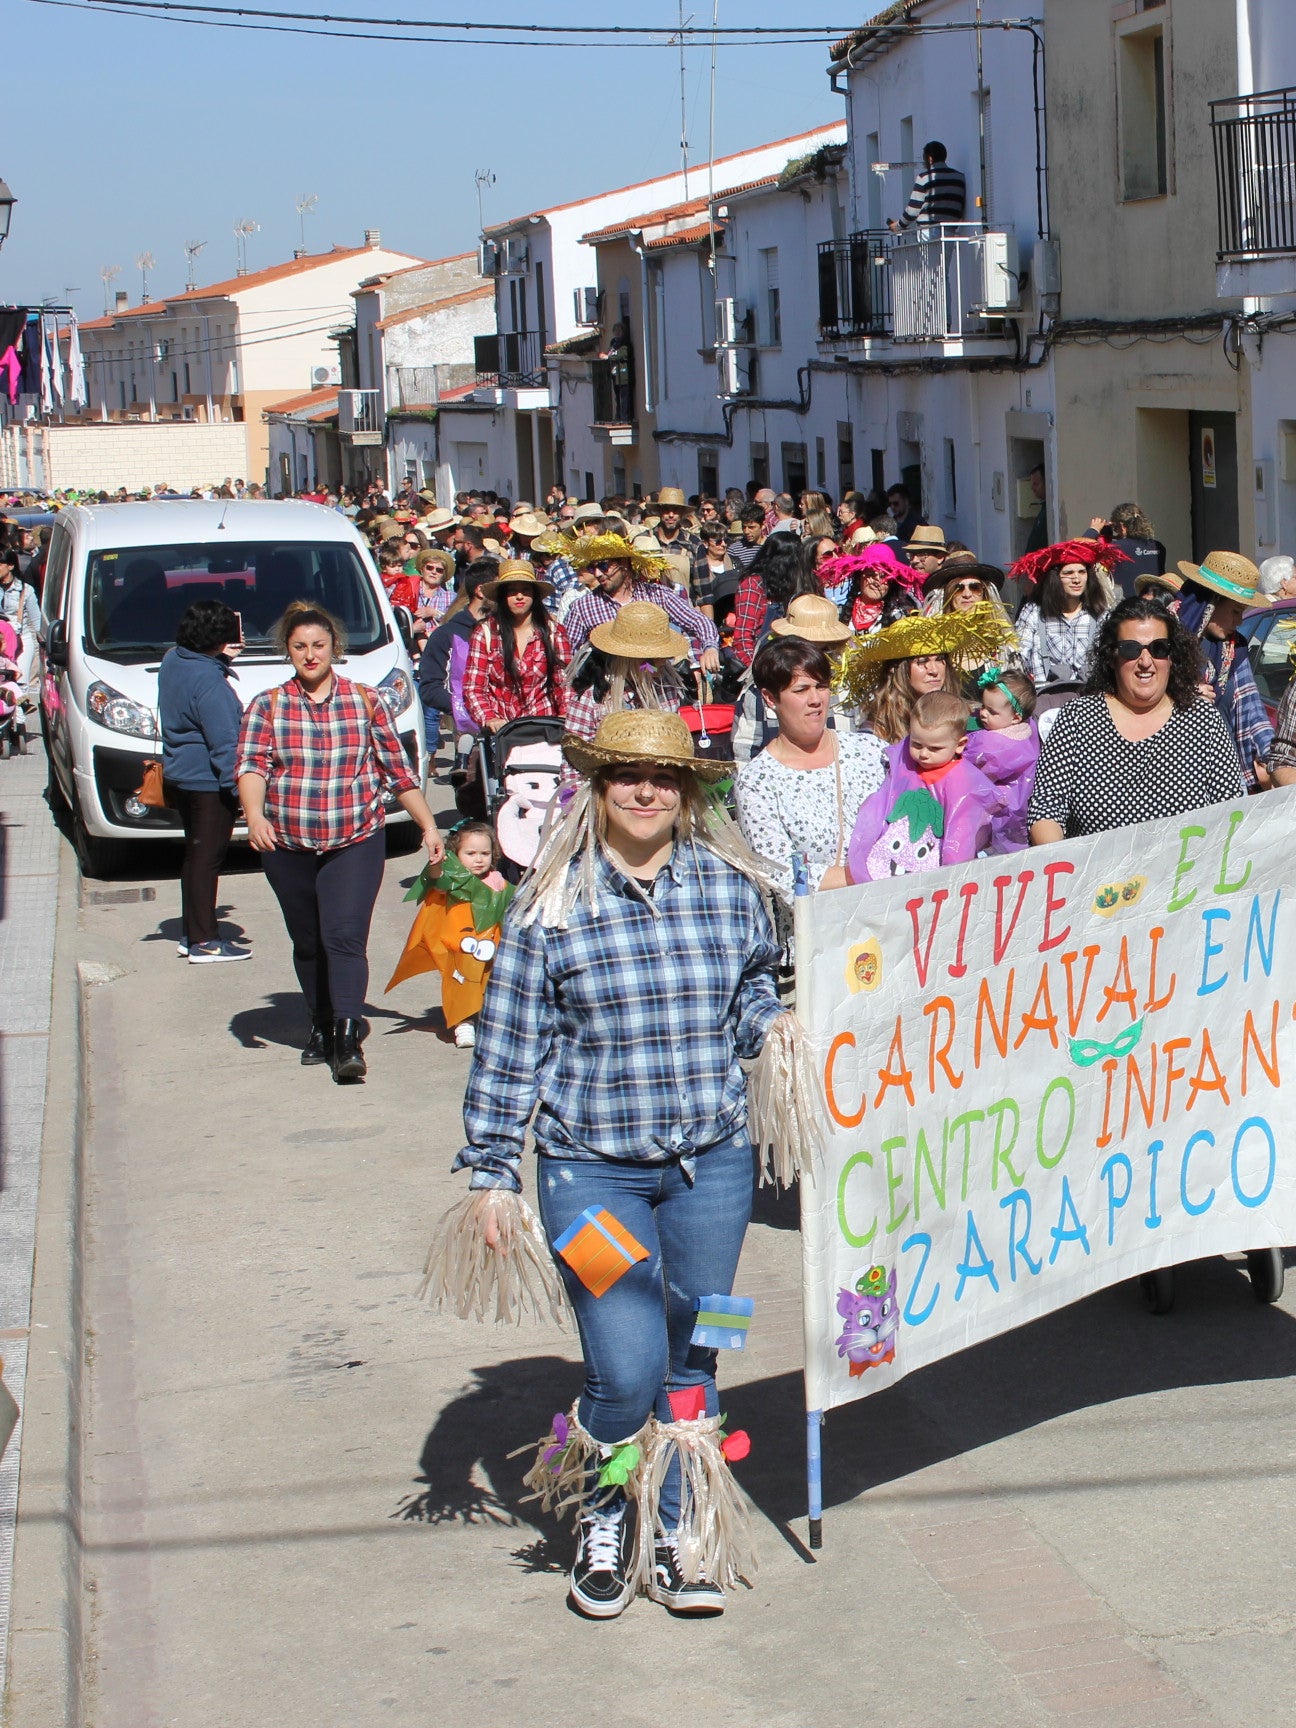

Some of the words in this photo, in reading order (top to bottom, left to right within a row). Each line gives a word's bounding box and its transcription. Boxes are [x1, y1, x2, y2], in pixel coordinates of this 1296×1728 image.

[905, 861, 1076, 988] VIVE
[1166, 810, 1253, 913] EL
[824, 926, 1177, 1129] CARNAVAL
[1197, 888, 1282, 997] EN
[836, 1076, 1077, 1249] CENTRO
[900, 1115, 1277, 1327] ZARAPICO
